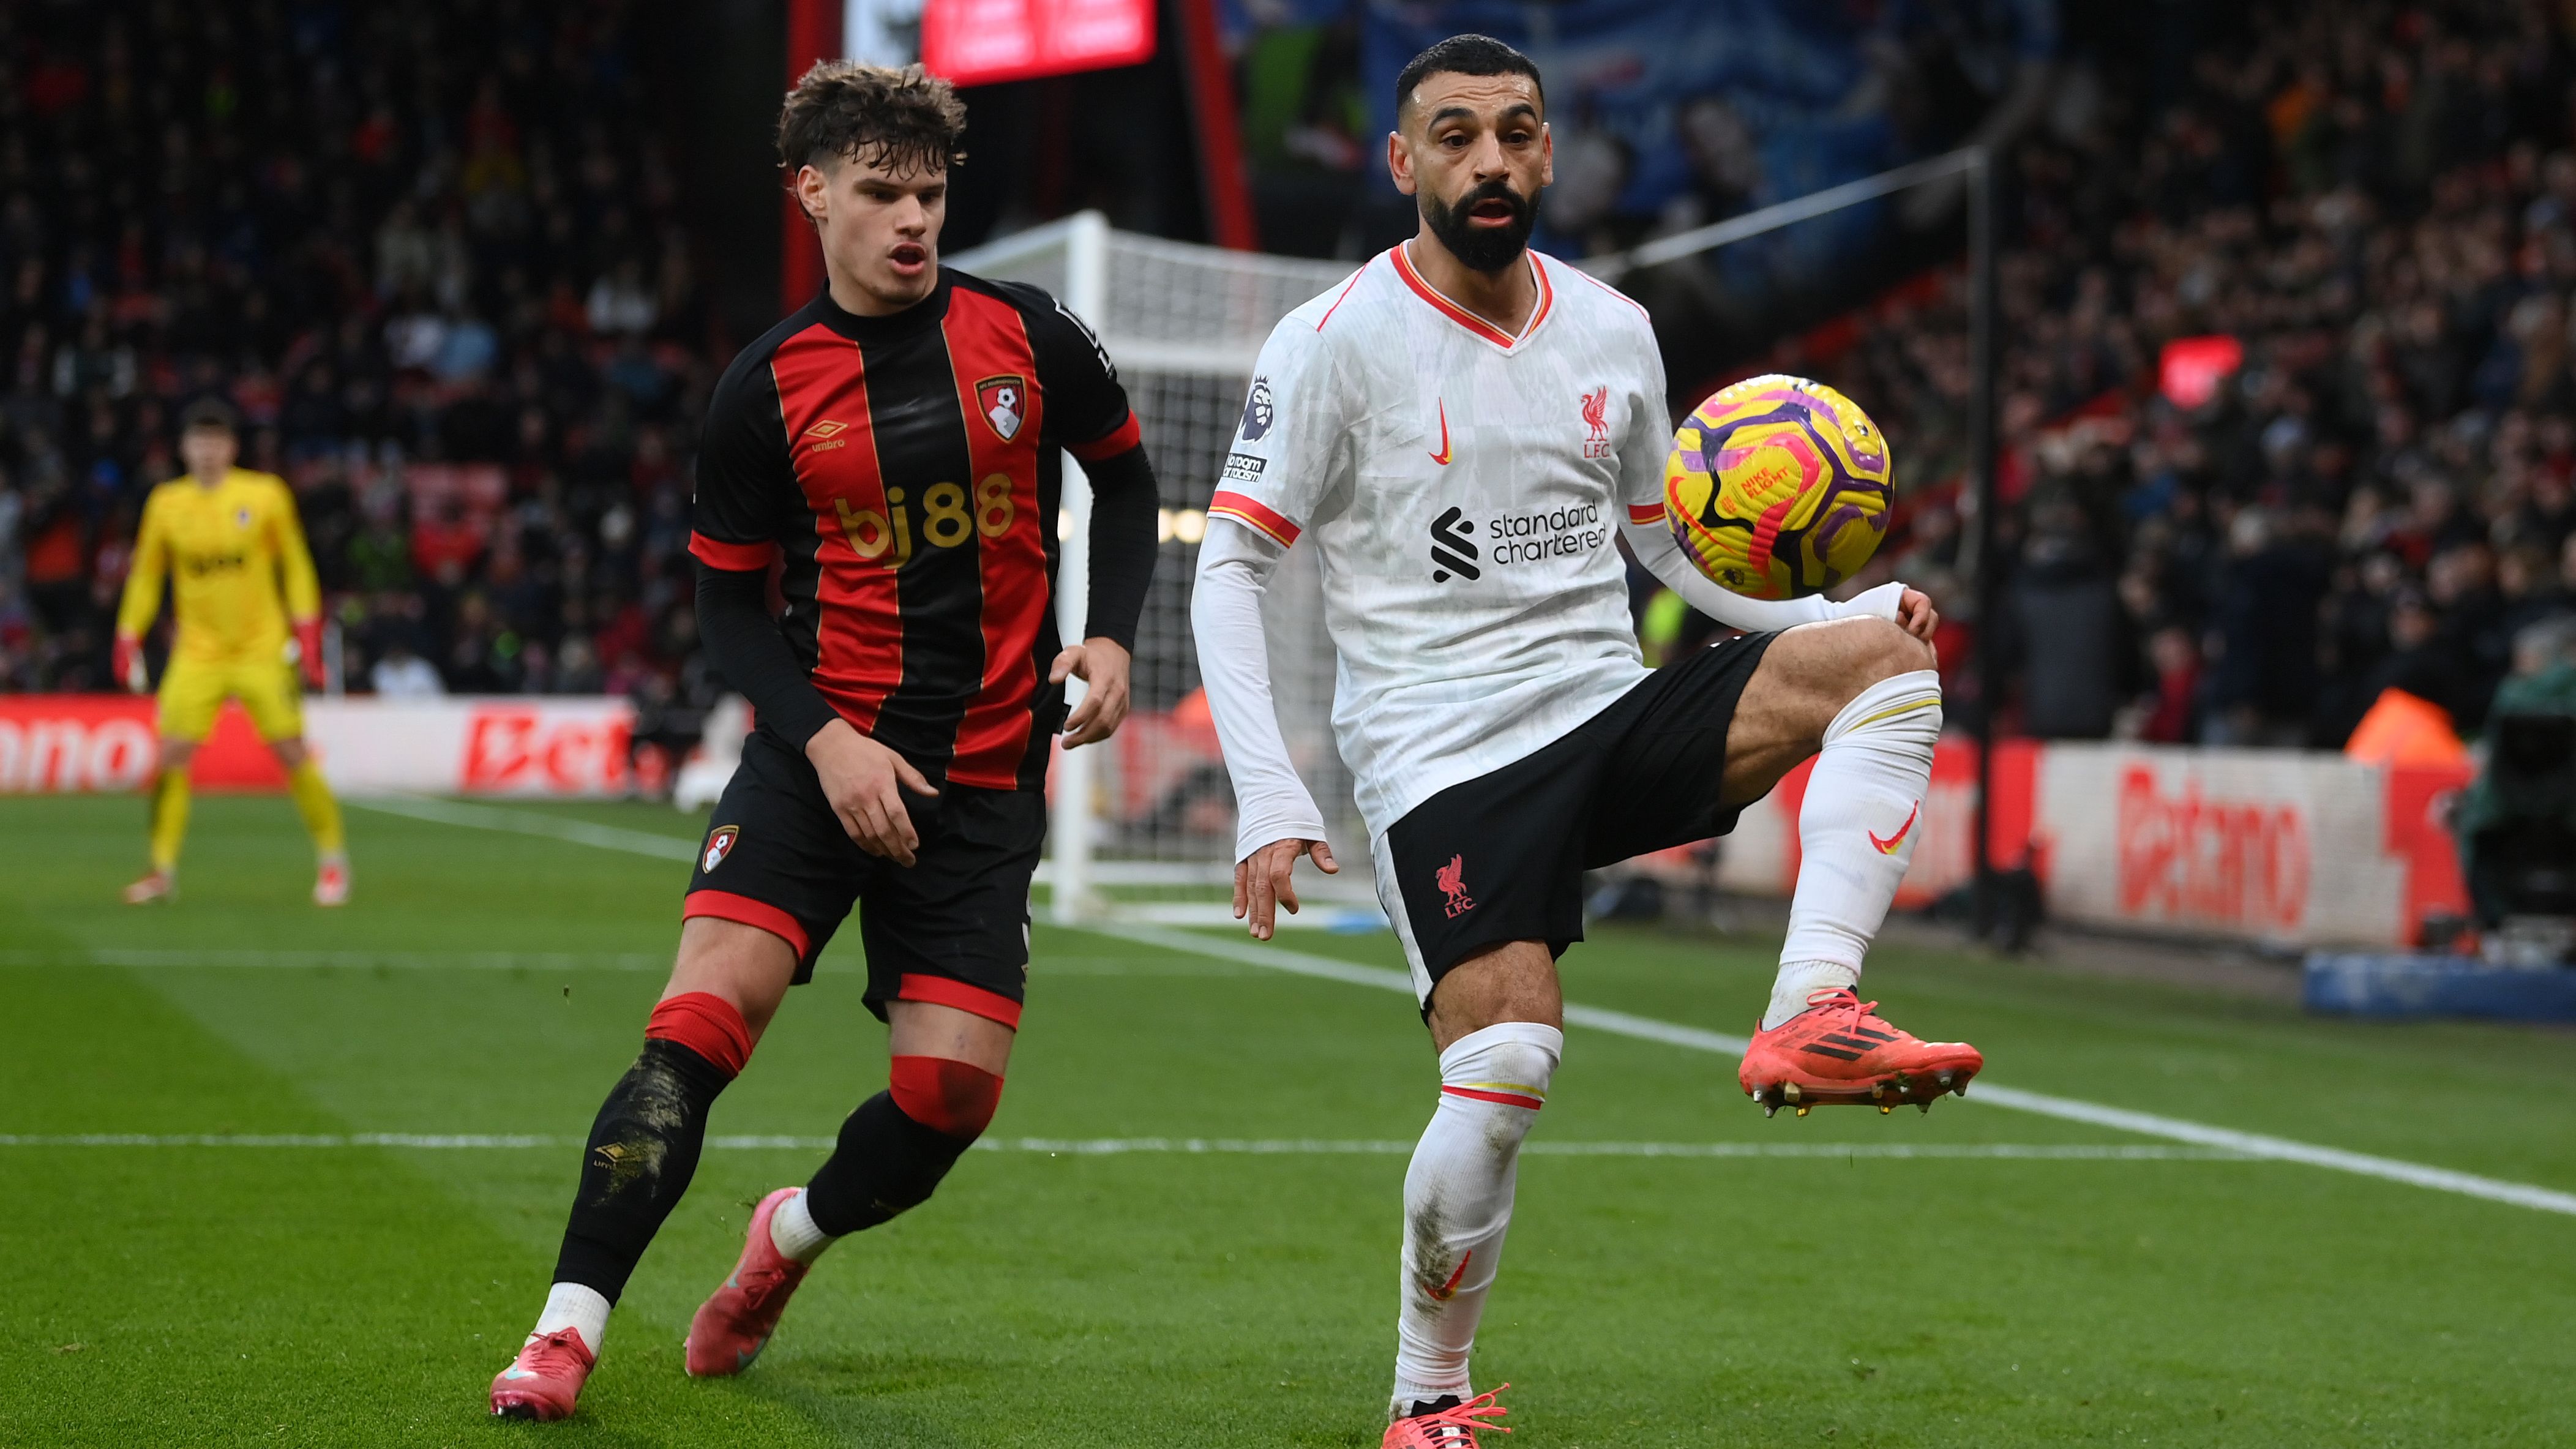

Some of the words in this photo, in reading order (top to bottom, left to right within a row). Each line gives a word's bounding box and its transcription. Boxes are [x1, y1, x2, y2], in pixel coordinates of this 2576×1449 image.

[812, 440, 844, 452] umbro
[1230, 468, 1261, 482] racism
[1234, 457, 1261, 471] room
[834, 473, 1014, 569] bj88
[1490, 499, 1598, 539] standard
[1494, 522, 1606, 564] chartered
